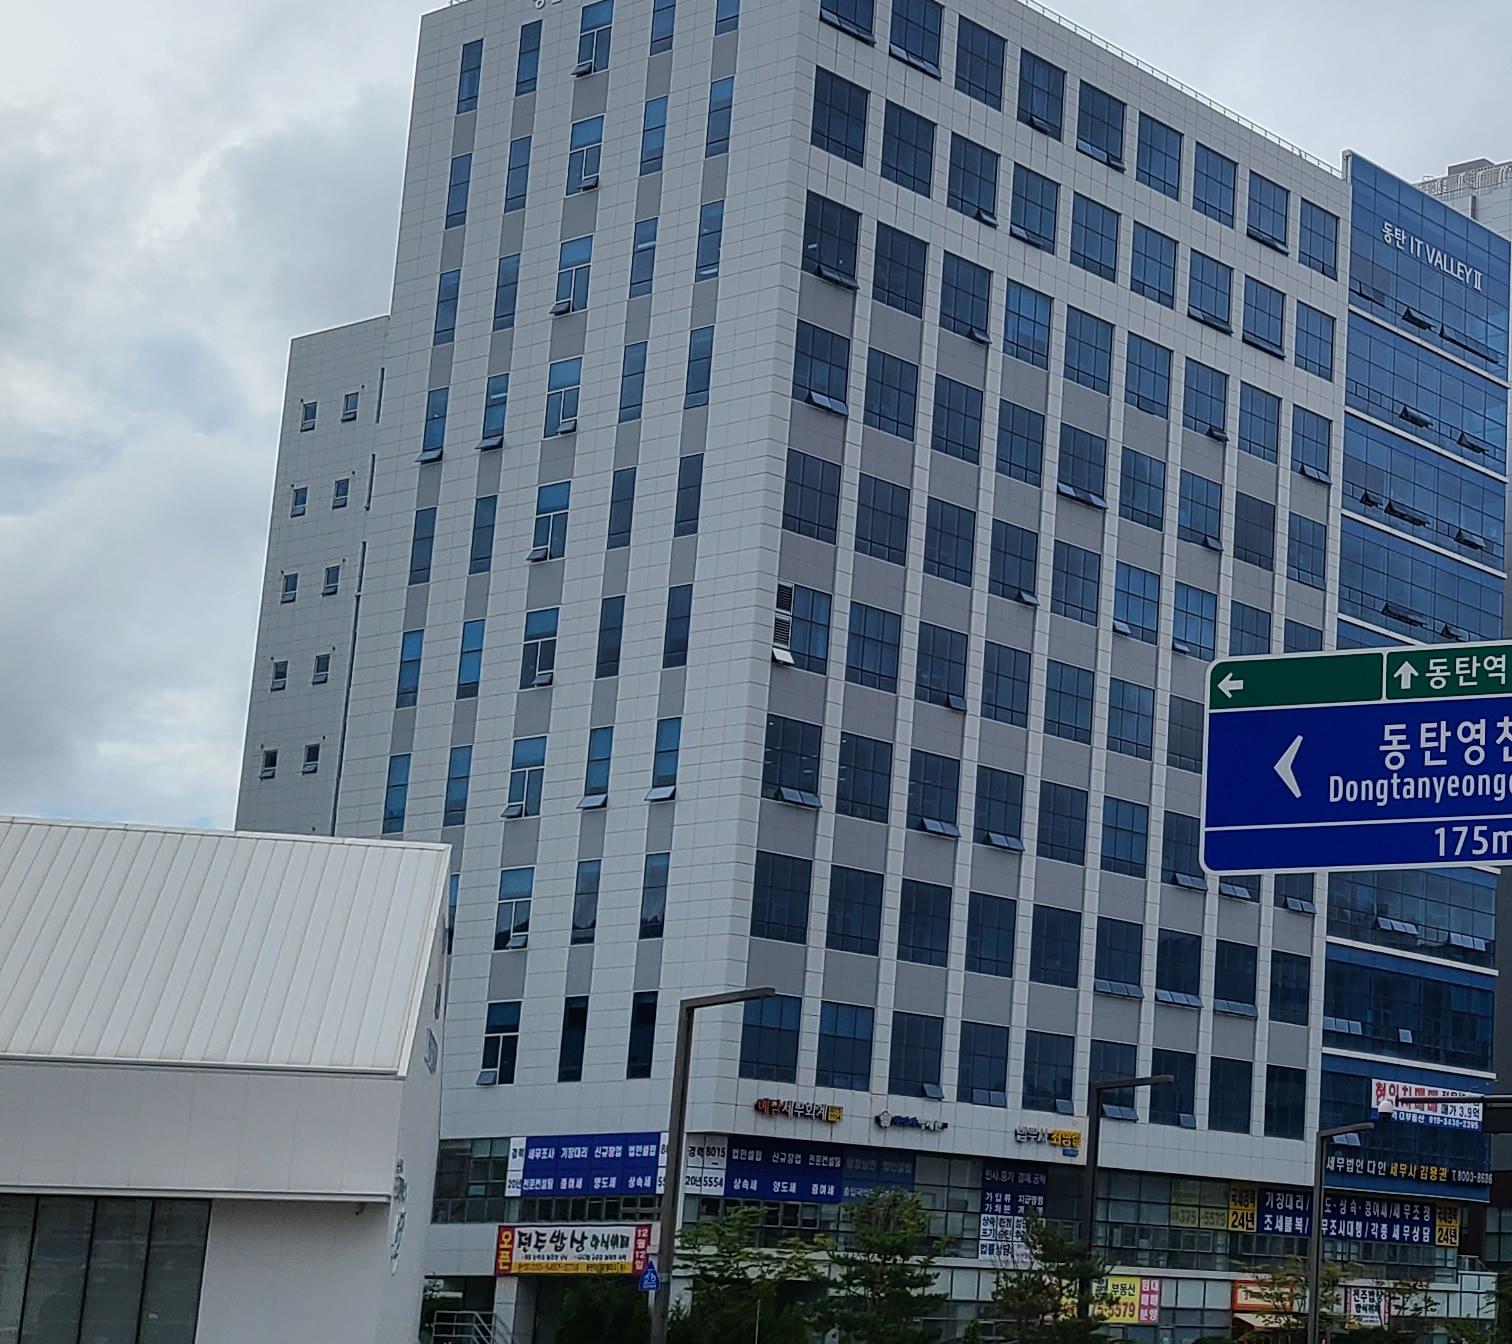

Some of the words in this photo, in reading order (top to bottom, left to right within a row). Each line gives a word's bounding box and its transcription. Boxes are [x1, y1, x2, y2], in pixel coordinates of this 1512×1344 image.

[1382, 222, 1406, 250] 동탄
[1410, 236, 1423, 258] IT
[1426, 244, 1473, 285] VALLEY
[1425, 654, 1507, 690] 동탄역
[1326, 1156, 1364, 1174] 세무법인
[1367, 1160, 1387, 1176] 다인
[1389, 1162, 1417, 1179] 세무사
[733, 1177, 758, 1191] 상속세
[772, 1180, 797, 1193] 양도세
[1230, 1210, 1256, 1231] 24년
[1436, 1227, 1458, 1244] 24년
[1112, 1283, 1136, 1297] 부동산
